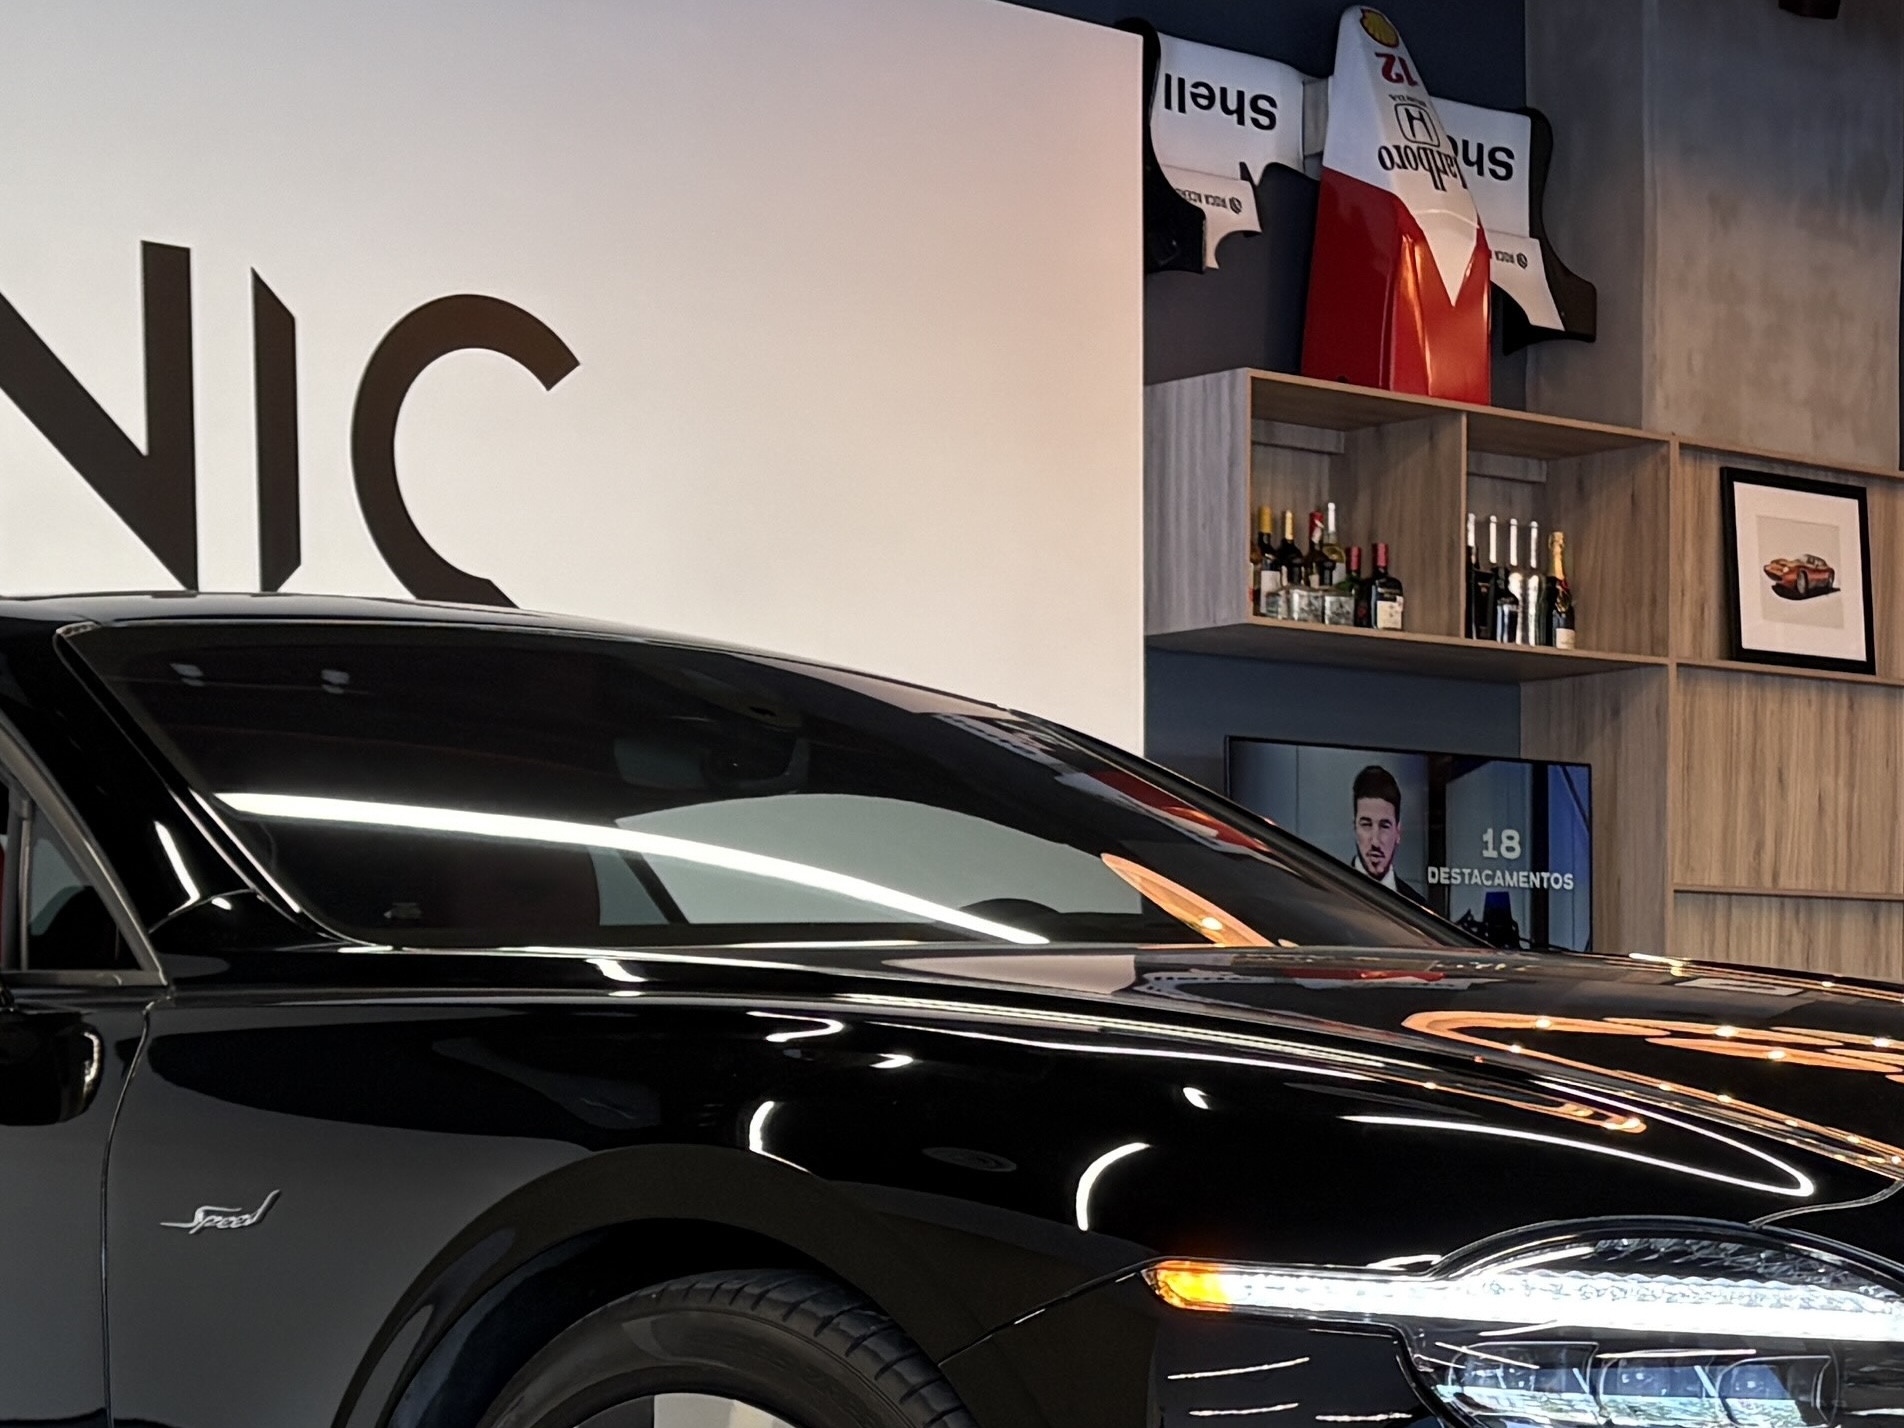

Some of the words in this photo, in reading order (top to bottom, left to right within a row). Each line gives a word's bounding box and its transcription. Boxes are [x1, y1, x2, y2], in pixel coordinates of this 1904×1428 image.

[1375, 52, 1418, 86] 12
[1164, 72, 1278, 131] Shell
[1482, 828, 1522, 860] 18
[1427, 866, 1574, 890] DESTACAMENTOS
